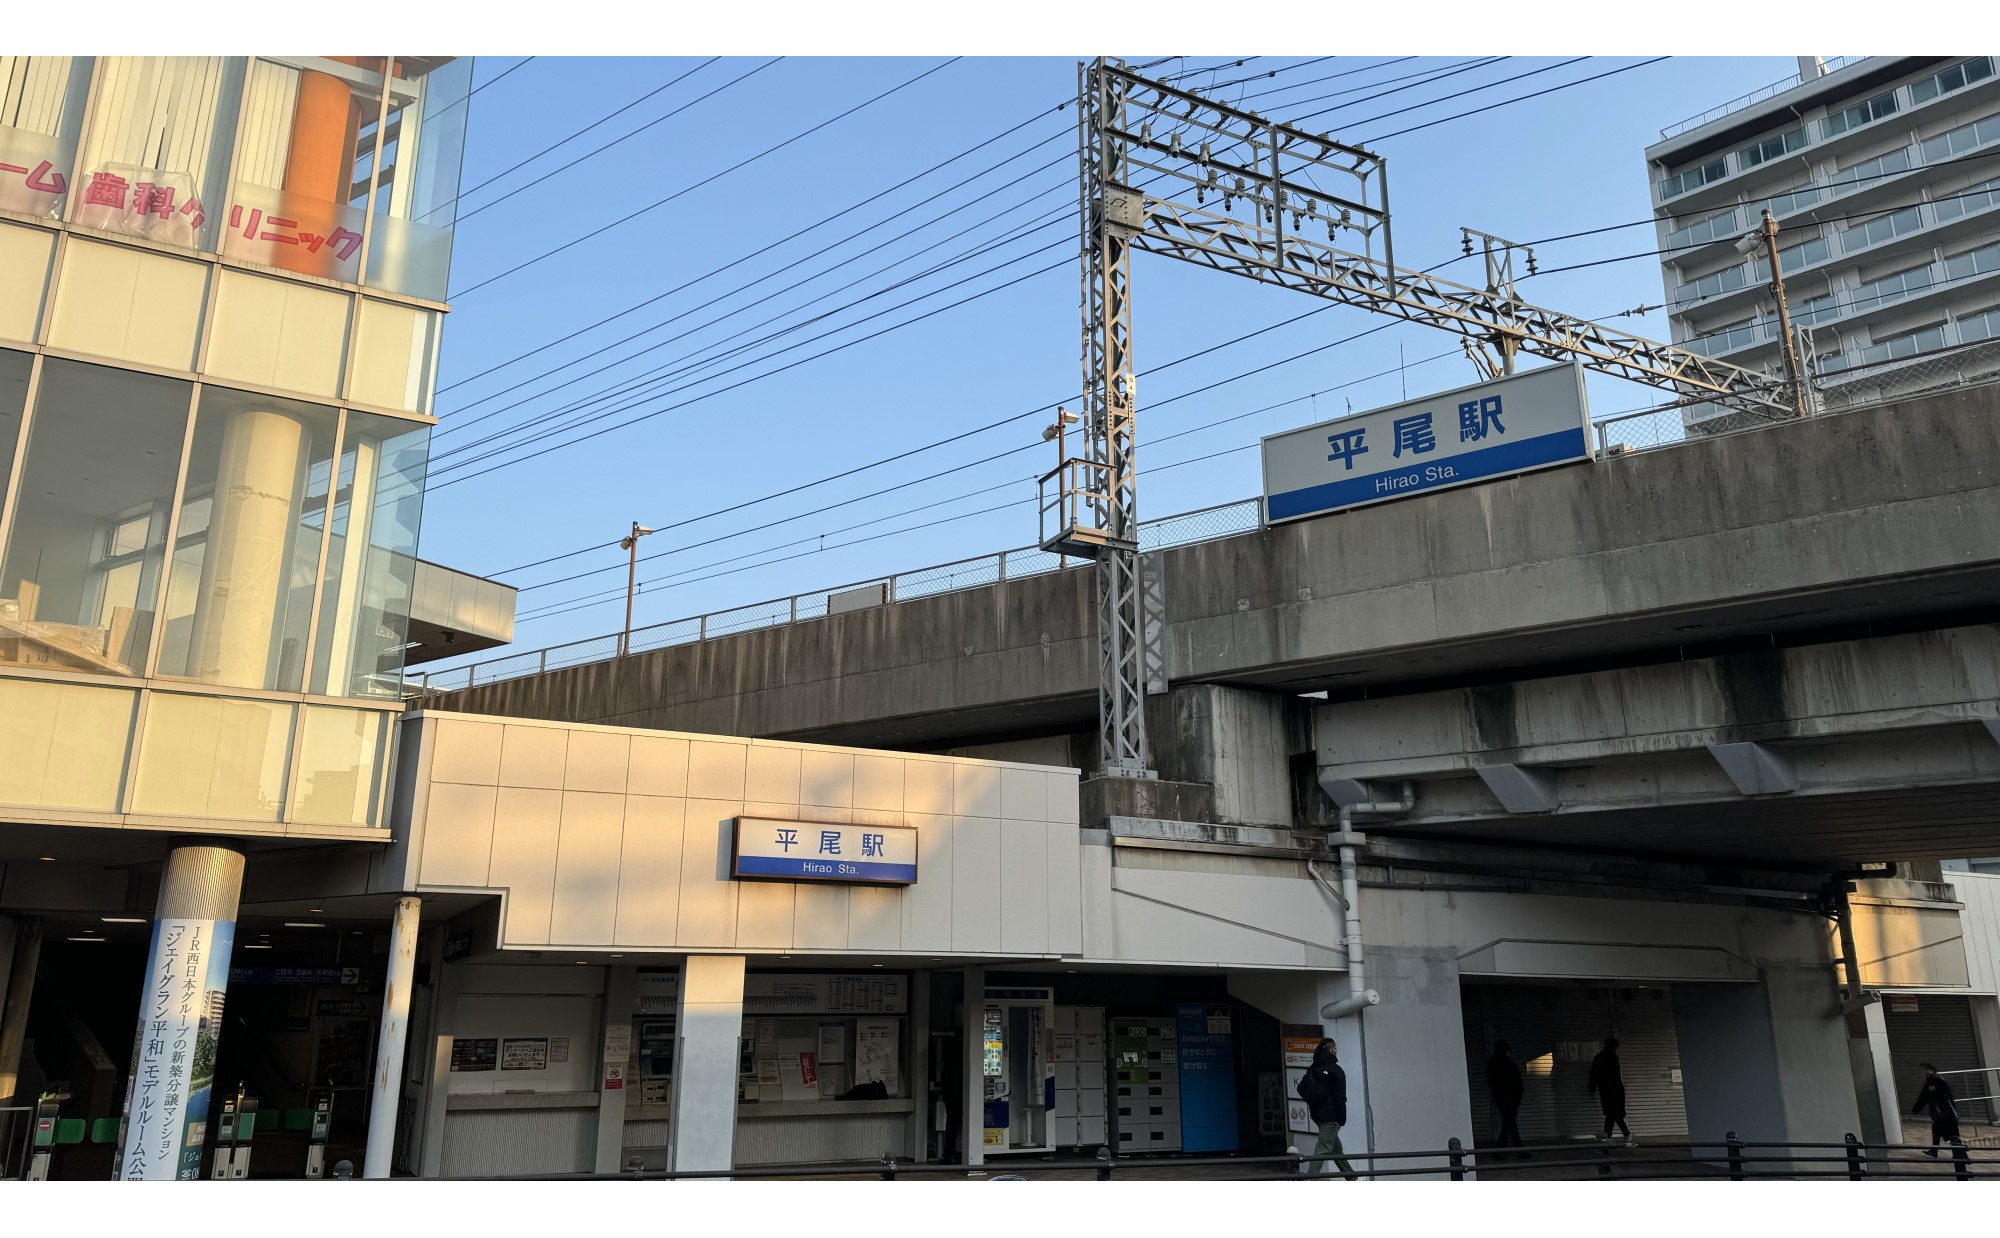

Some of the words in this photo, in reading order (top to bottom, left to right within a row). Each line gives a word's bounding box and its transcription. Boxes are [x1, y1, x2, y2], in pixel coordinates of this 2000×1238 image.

[1327, 394, 1506, 471] 平尾駅
[1375, 472, 1419, 494] Hirao
[1425, 465, 1460, 483] Sta.
[774, 828, 884, 858] 平尾駅
[803, 861, 833, 874] Hirao
[838, 863, 860, 875] Sta.
[127, 924, 186, 1181] 「ジェイグラン平和」モデルルーム公
[157, 926, 201, 1161] JR西日本グループの新築分譲マンション
